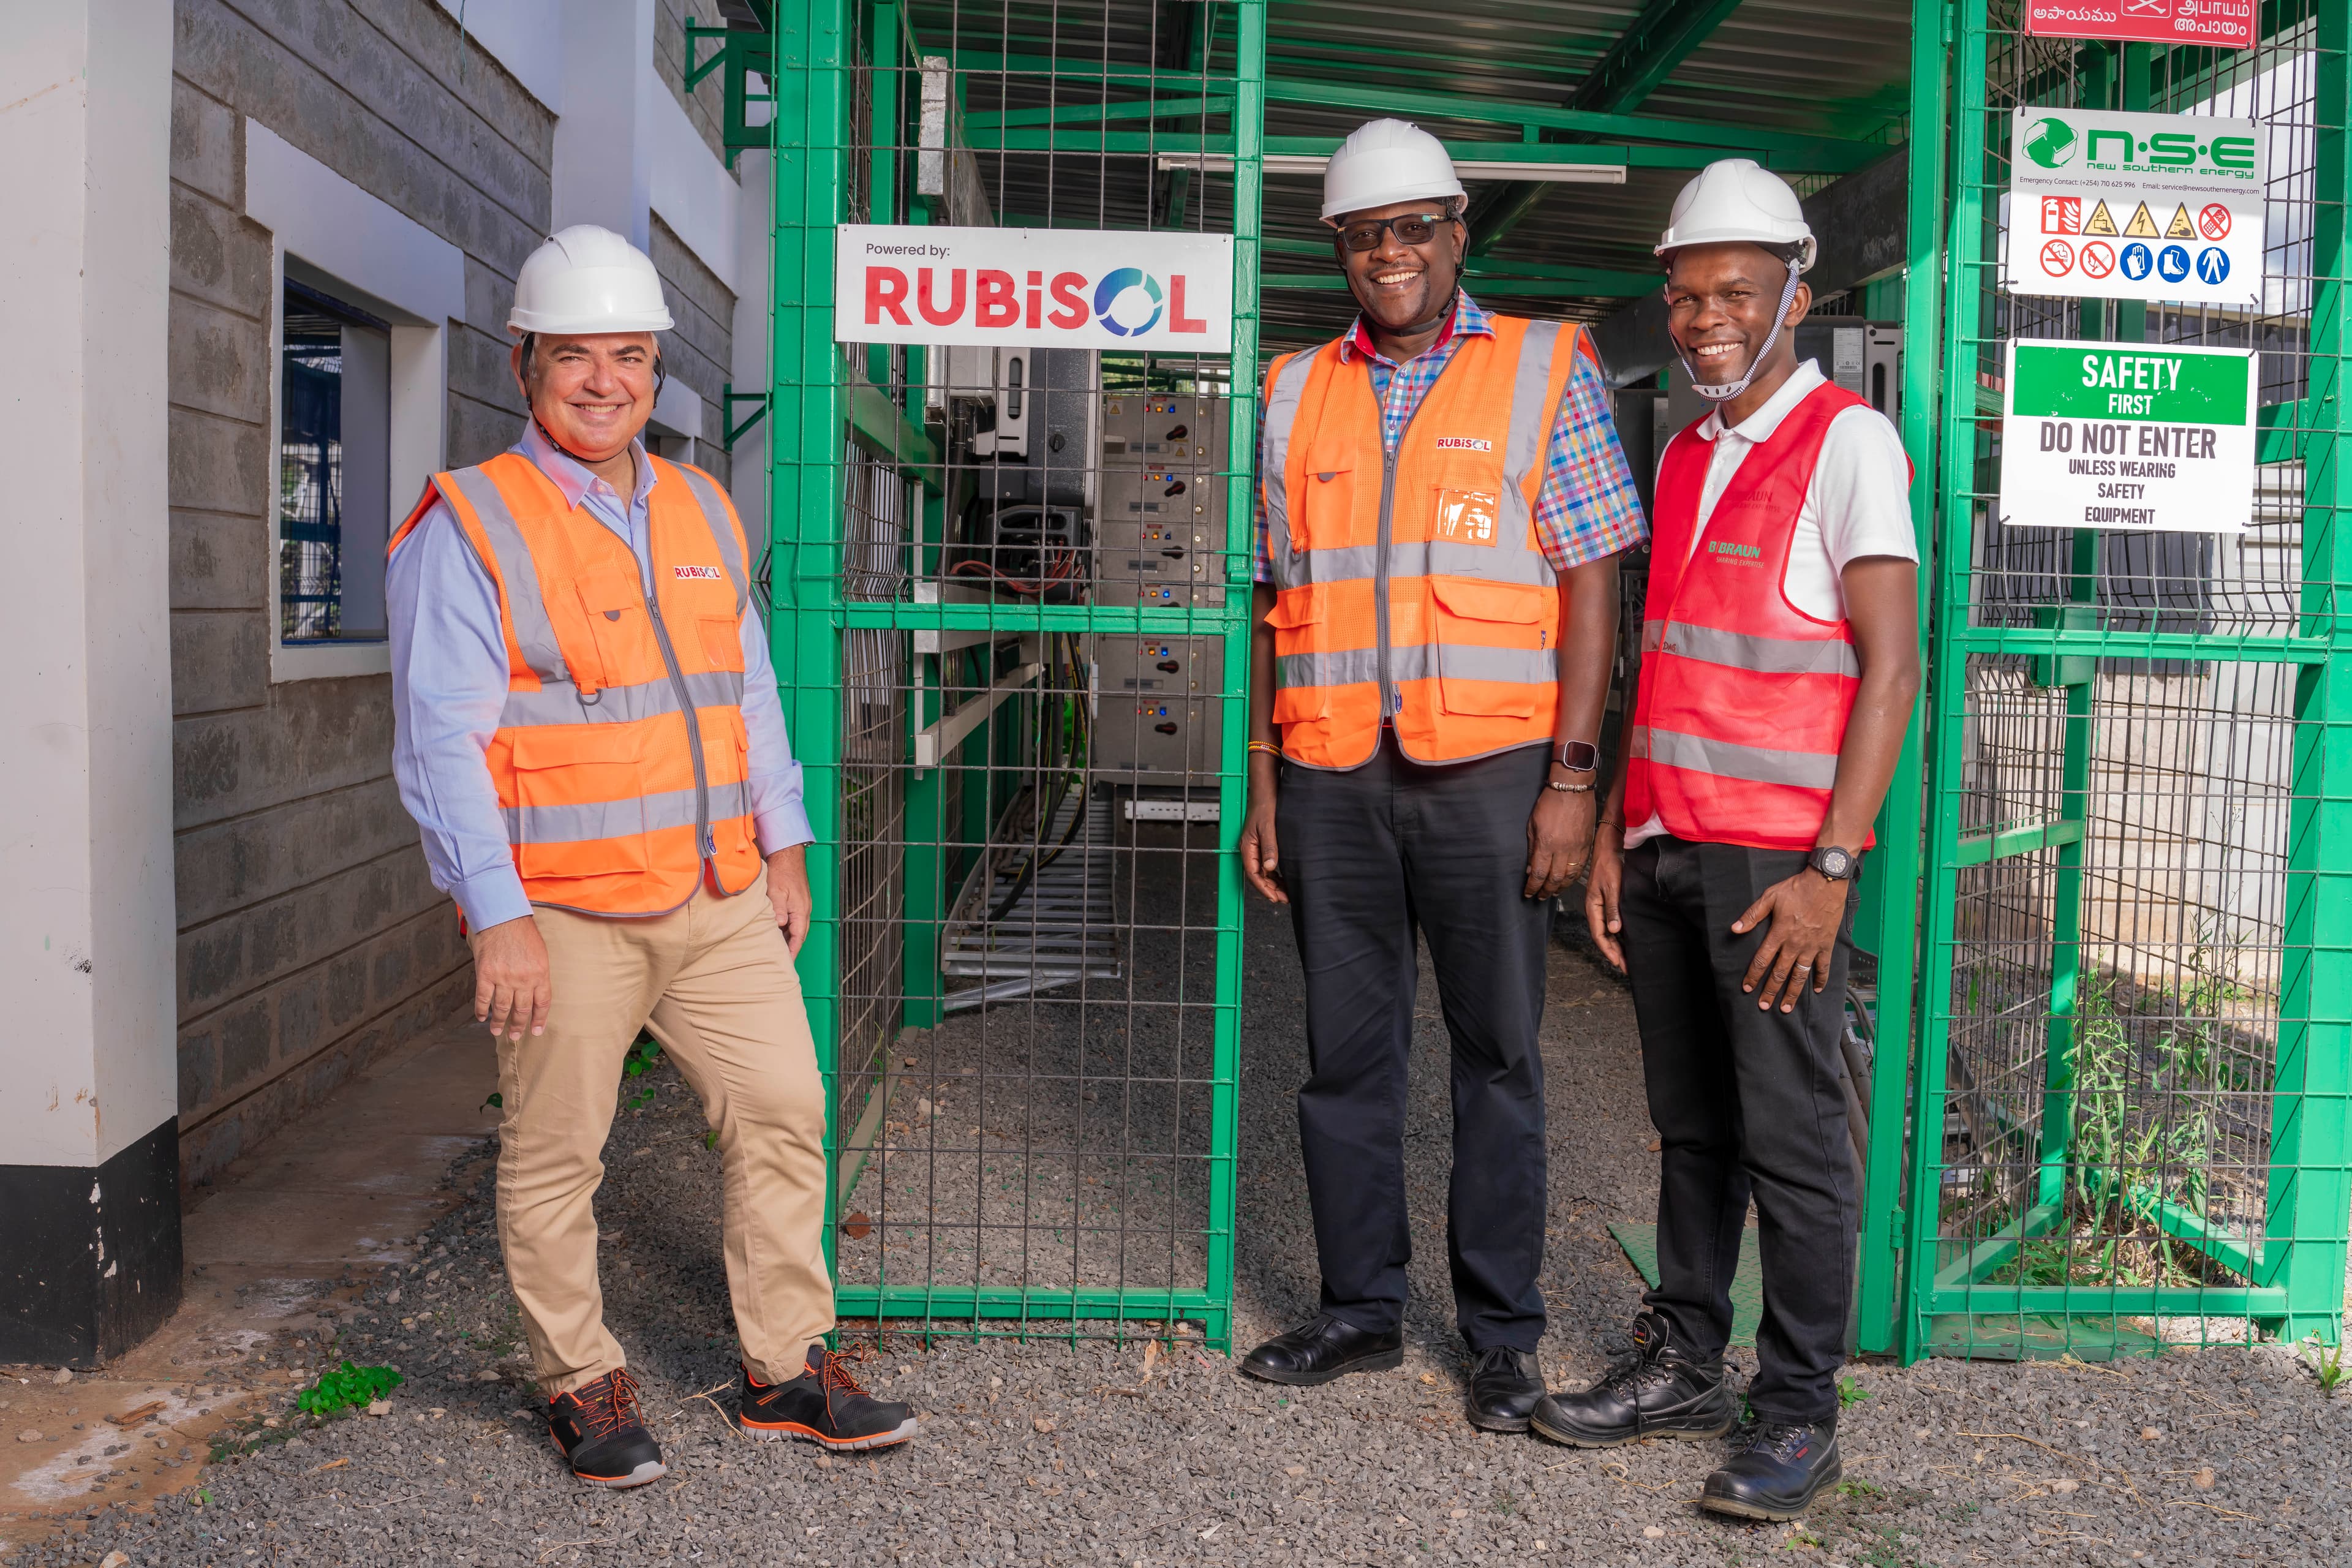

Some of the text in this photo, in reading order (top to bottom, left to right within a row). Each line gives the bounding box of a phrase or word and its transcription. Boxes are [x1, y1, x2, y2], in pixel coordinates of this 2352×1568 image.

[2020, 176, 2052, 185] Emergency
[2162, 184, 2260, 195] service@newsouthernenergy.com
[866, 243, 950, 259] Powered by:
[2082, 355, 2182, 390] SAFETY
[2109, 394, 2153, 415] FIRST
[2040, 421, 2216, 459] DO NOT ENTER
[2069, 459, 2176, 478] UNLESS WEARING
[2098, 483, 2145, 499] SAFETY
[2085, 507, 2155, 524] EQUIPMENT
[1716, 556, 1765, 568] SHARING EXPERTISE
